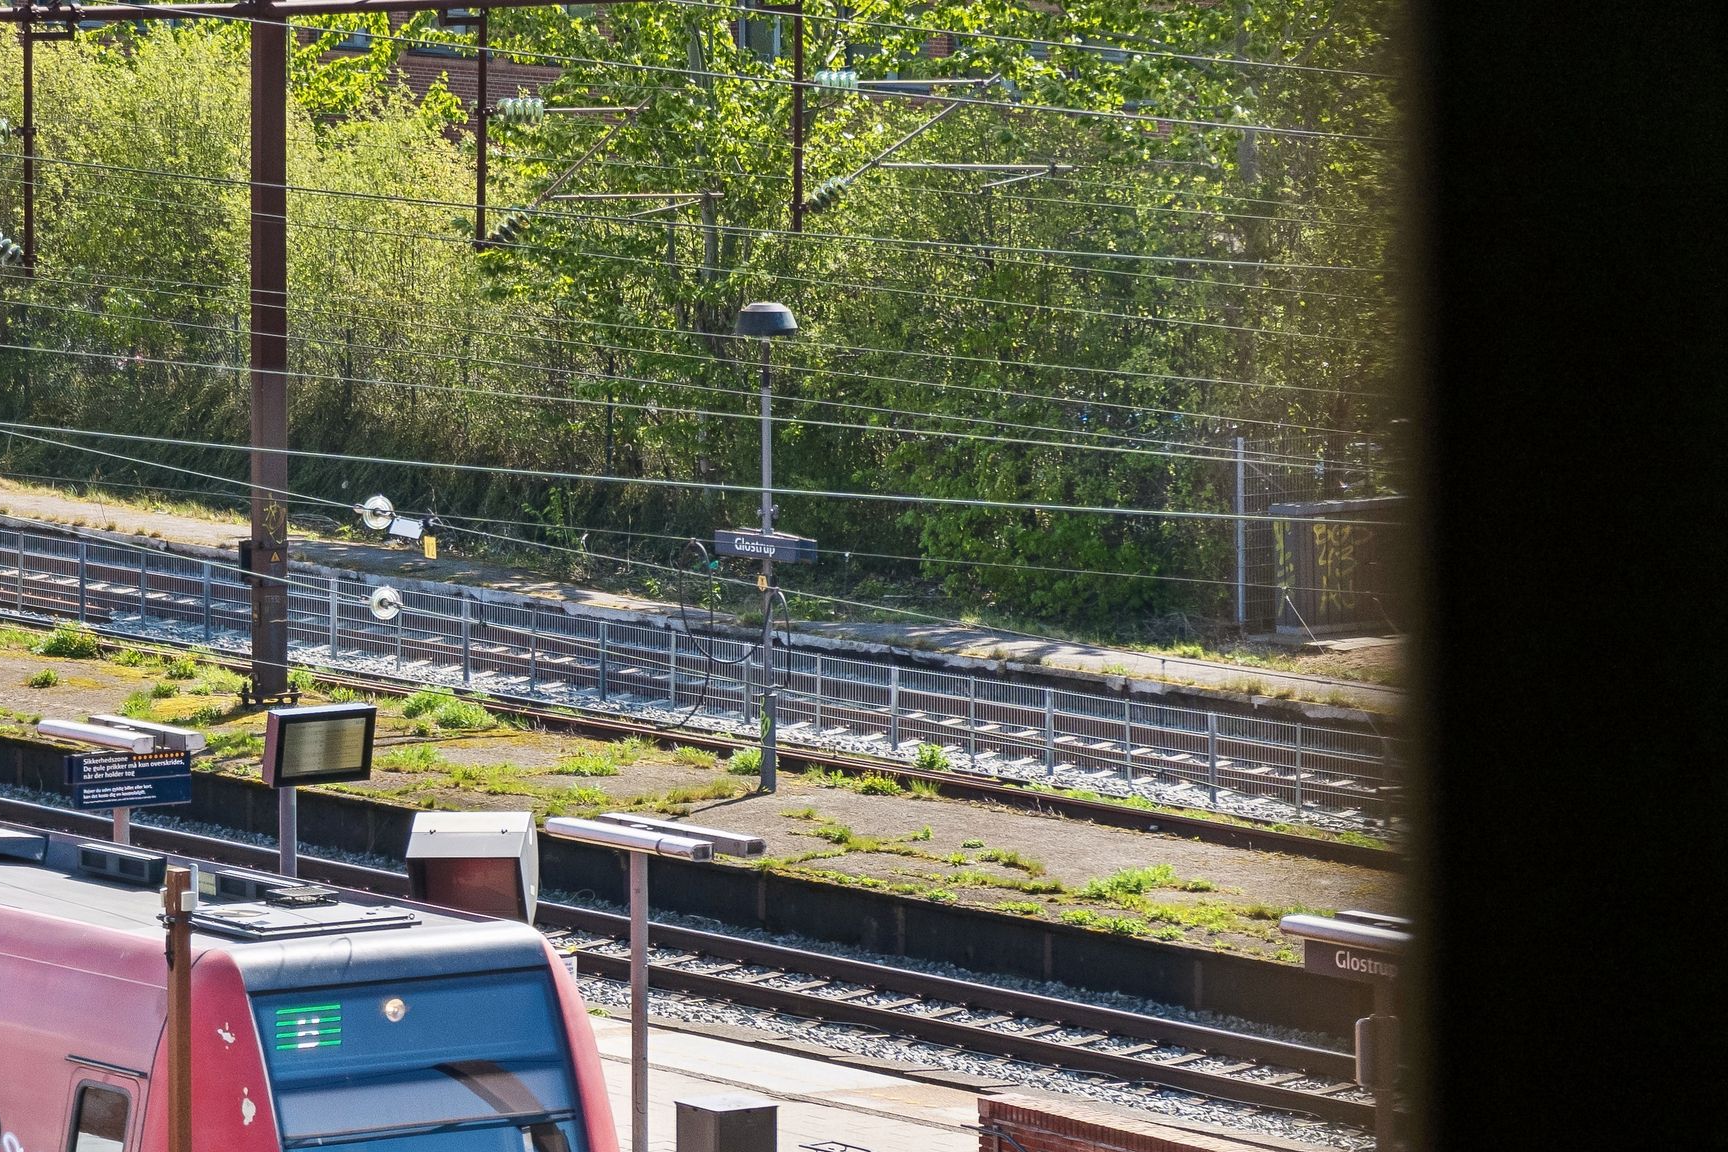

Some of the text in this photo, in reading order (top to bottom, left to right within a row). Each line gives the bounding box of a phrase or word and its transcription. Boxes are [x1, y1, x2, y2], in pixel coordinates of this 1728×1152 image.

[735, 537, 776, 557] Glostrup
[83, 756, 129, 766] Sikkerhedszone
[83, 758, 185, 773] De gule prikker må kun overskrides,
[83, 772, 93, 780] når
[105, 771, 124, 779] holder
[1335, 950, 1399, 979] Glostrup
